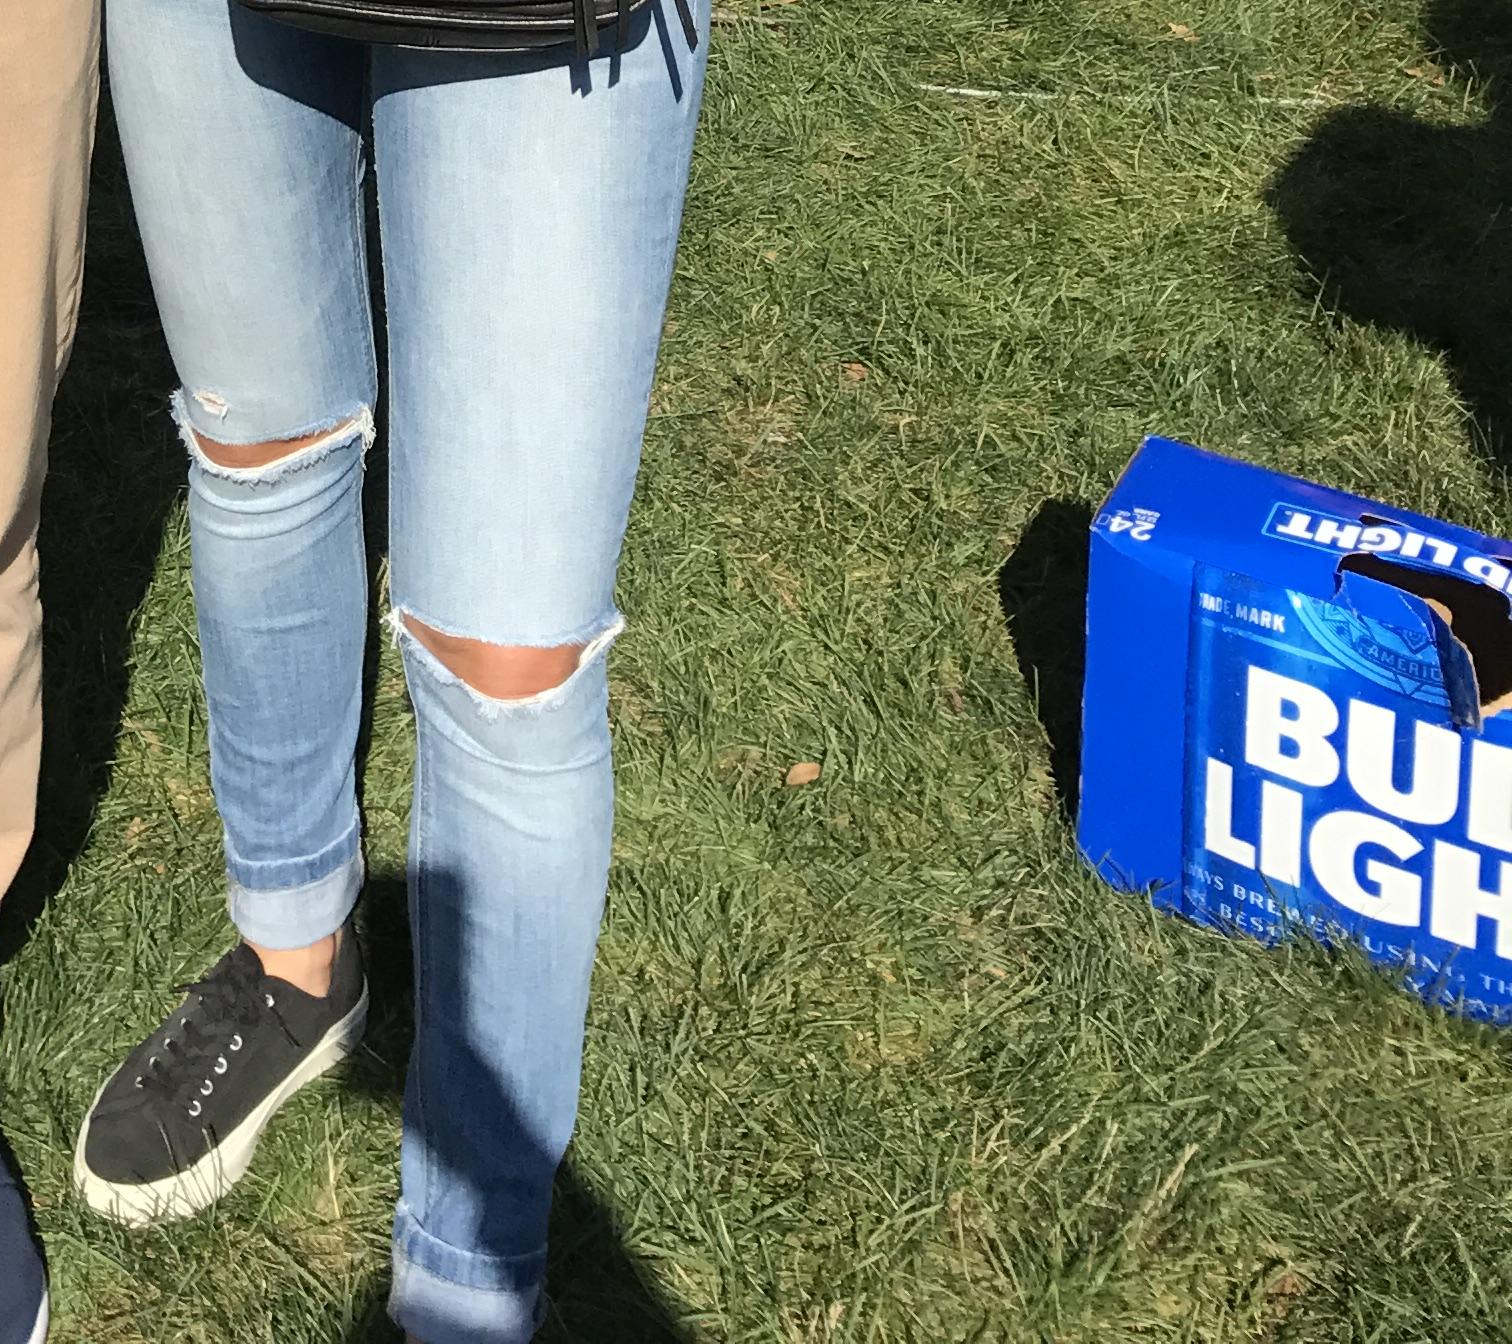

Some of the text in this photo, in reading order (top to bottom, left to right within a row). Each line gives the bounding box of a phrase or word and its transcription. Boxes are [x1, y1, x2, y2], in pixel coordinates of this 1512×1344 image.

[1109, 516, 1156, 541] 24
[1276, 511, 1458, 567] LIGHT
[1235, 602, 1286, 633] MARK
